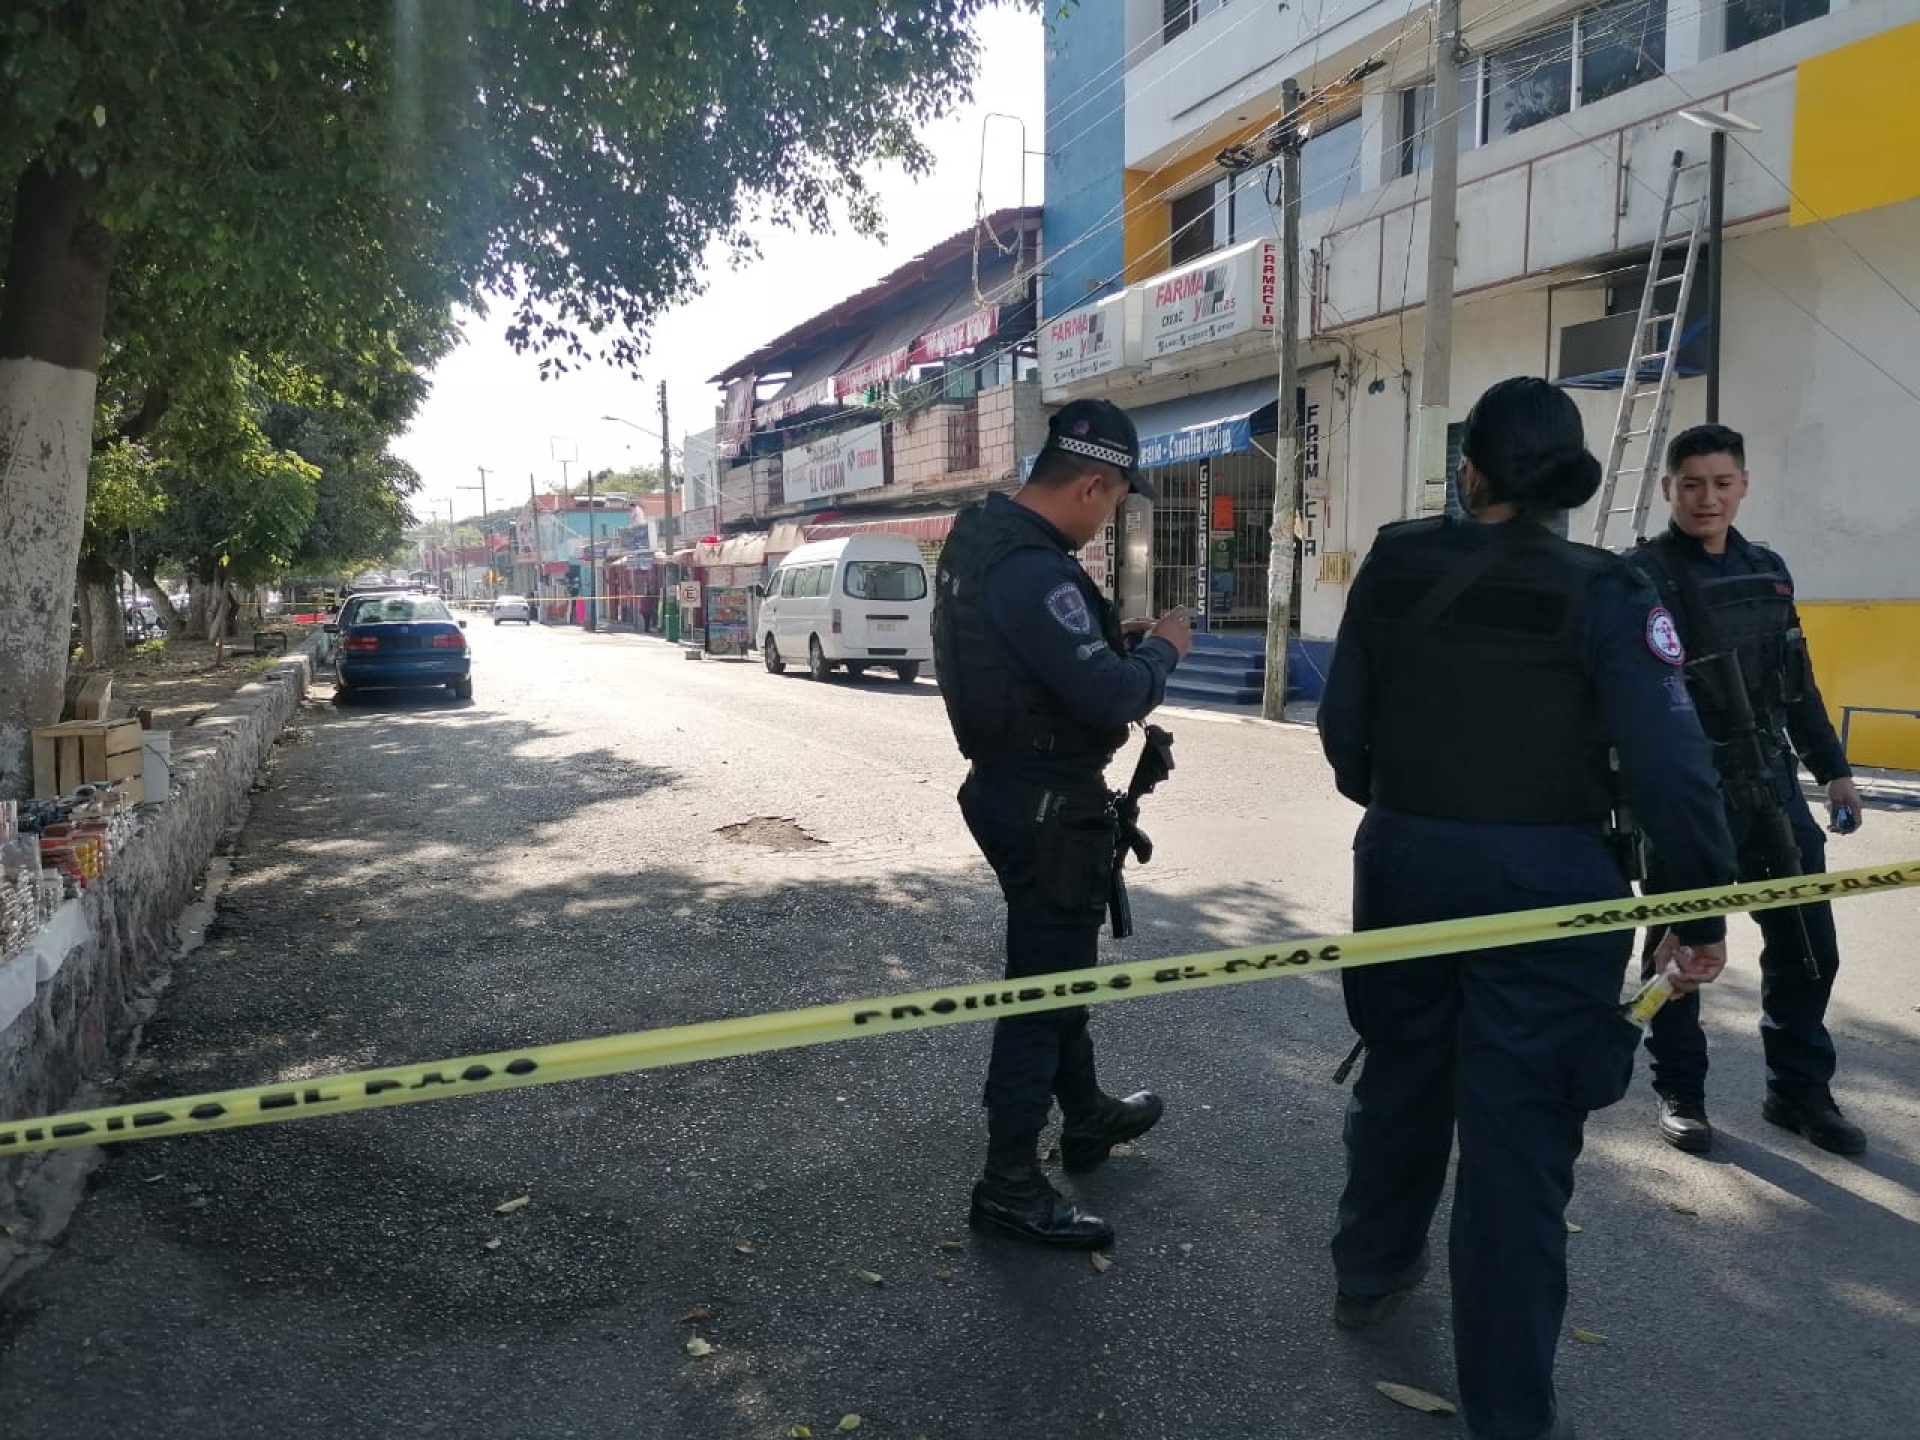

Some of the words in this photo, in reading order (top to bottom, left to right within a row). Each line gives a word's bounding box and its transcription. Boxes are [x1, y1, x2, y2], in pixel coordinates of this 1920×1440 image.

[1155, 270, 1204, 309] FARMA
[1262, 244, 1276, 325] FARMACIA
[1051, 314, 1088, 344] FARMA
[1197, 464, 1208, 616] GENERICOS
